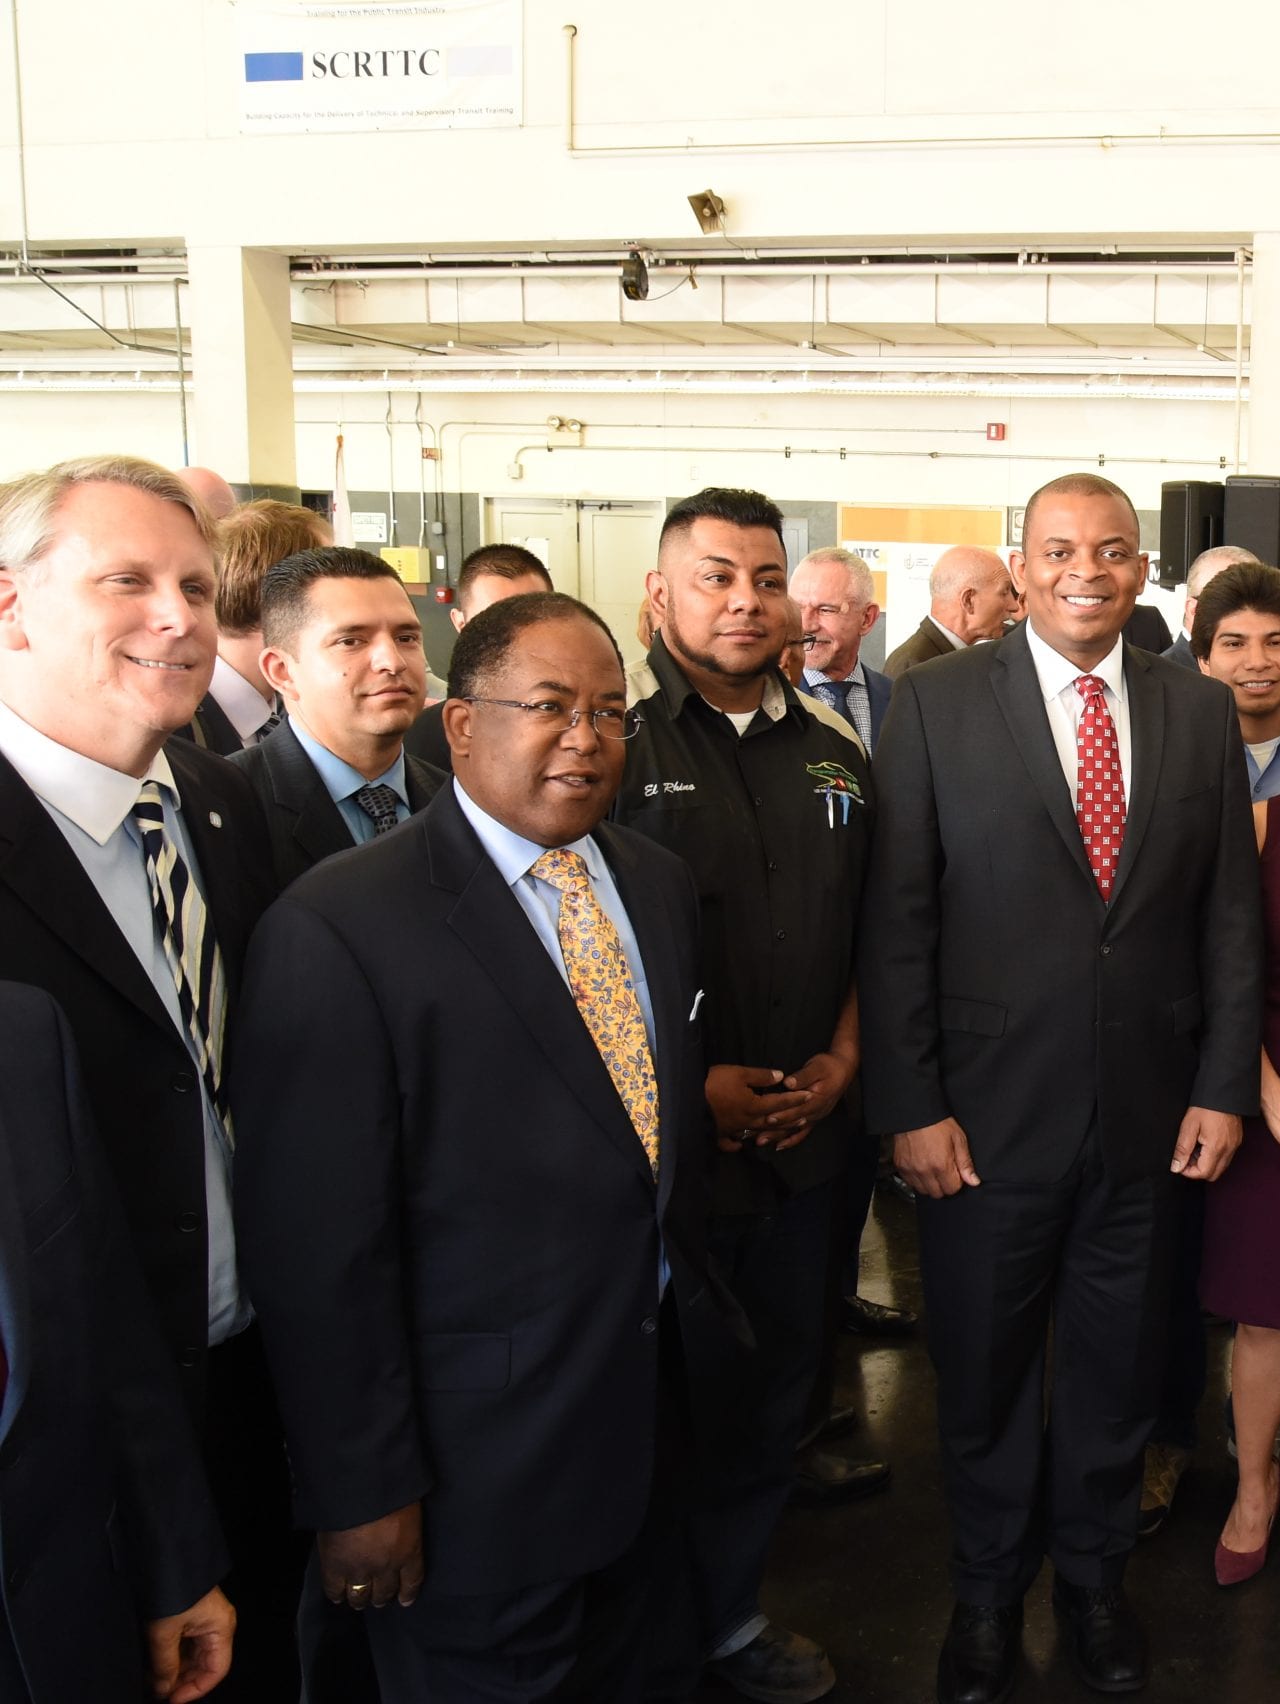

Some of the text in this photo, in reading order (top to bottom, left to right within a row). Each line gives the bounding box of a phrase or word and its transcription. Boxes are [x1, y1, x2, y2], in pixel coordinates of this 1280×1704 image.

[363, 8, 384, 16] Public
[386, 8, 412, 16] Transit
[414, 7, 446, 16] Industry
[312, 48, 440, 79] SCRTTC
[273, 112, 301, 120] Capacity
[327, 111, 354, 119] Delivery
[415, 109, 455, 118] Supervisory
[486, 107, 514, 115] Training
[644, 781, 696, 797] El Rhino
